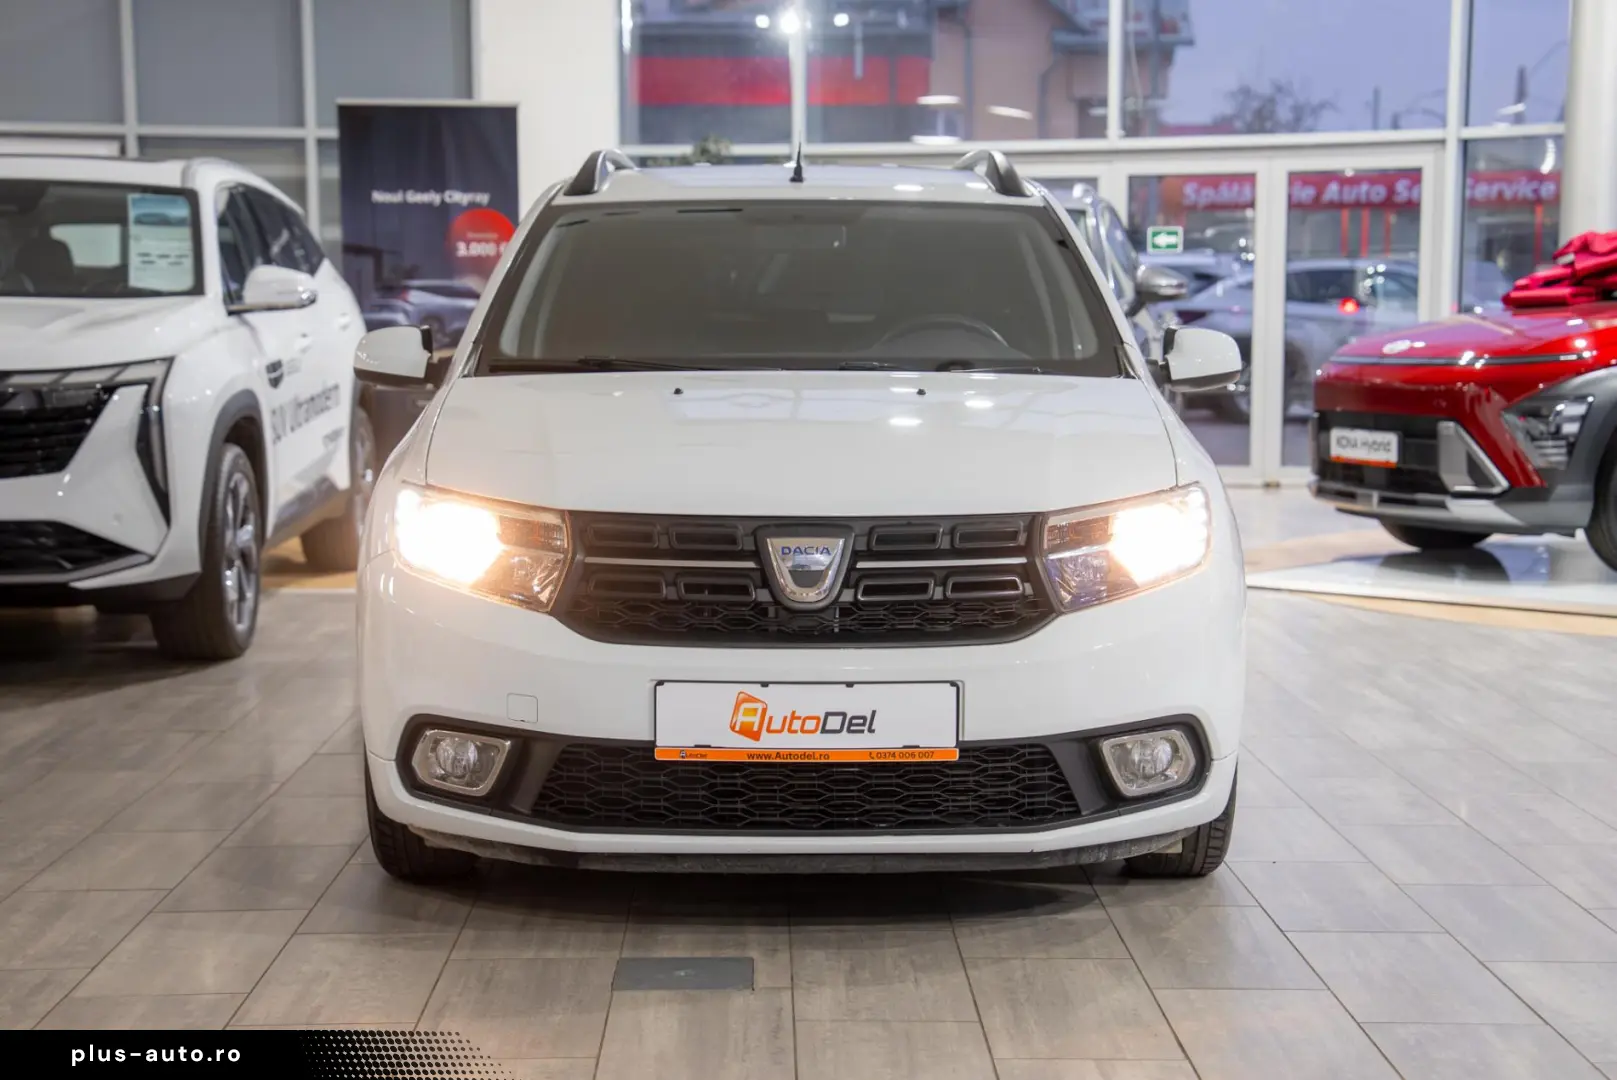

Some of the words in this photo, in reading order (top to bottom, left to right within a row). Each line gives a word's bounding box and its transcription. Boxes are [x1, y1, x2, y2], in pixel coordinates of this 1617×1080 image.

[371, 190, 403, 204] Noul
[406, 190, 442, 206] Geely
[444, 190, 490, 207] Cityray
[1322, 180, 1387, 205] Auto
[1393, 177, 1421, 204] Se
[1360, 437, 1391, 455] Hybrid
[781, 545, 832, 556] DACIA
[733, 697, 877, 736] AutoDel
[746, 751, 830, 761] www.Autodel.ro
[875, 751, 896, 760] 0374
[898, 751, 916, 760] 006
[917, 751, 935, 760] 007
